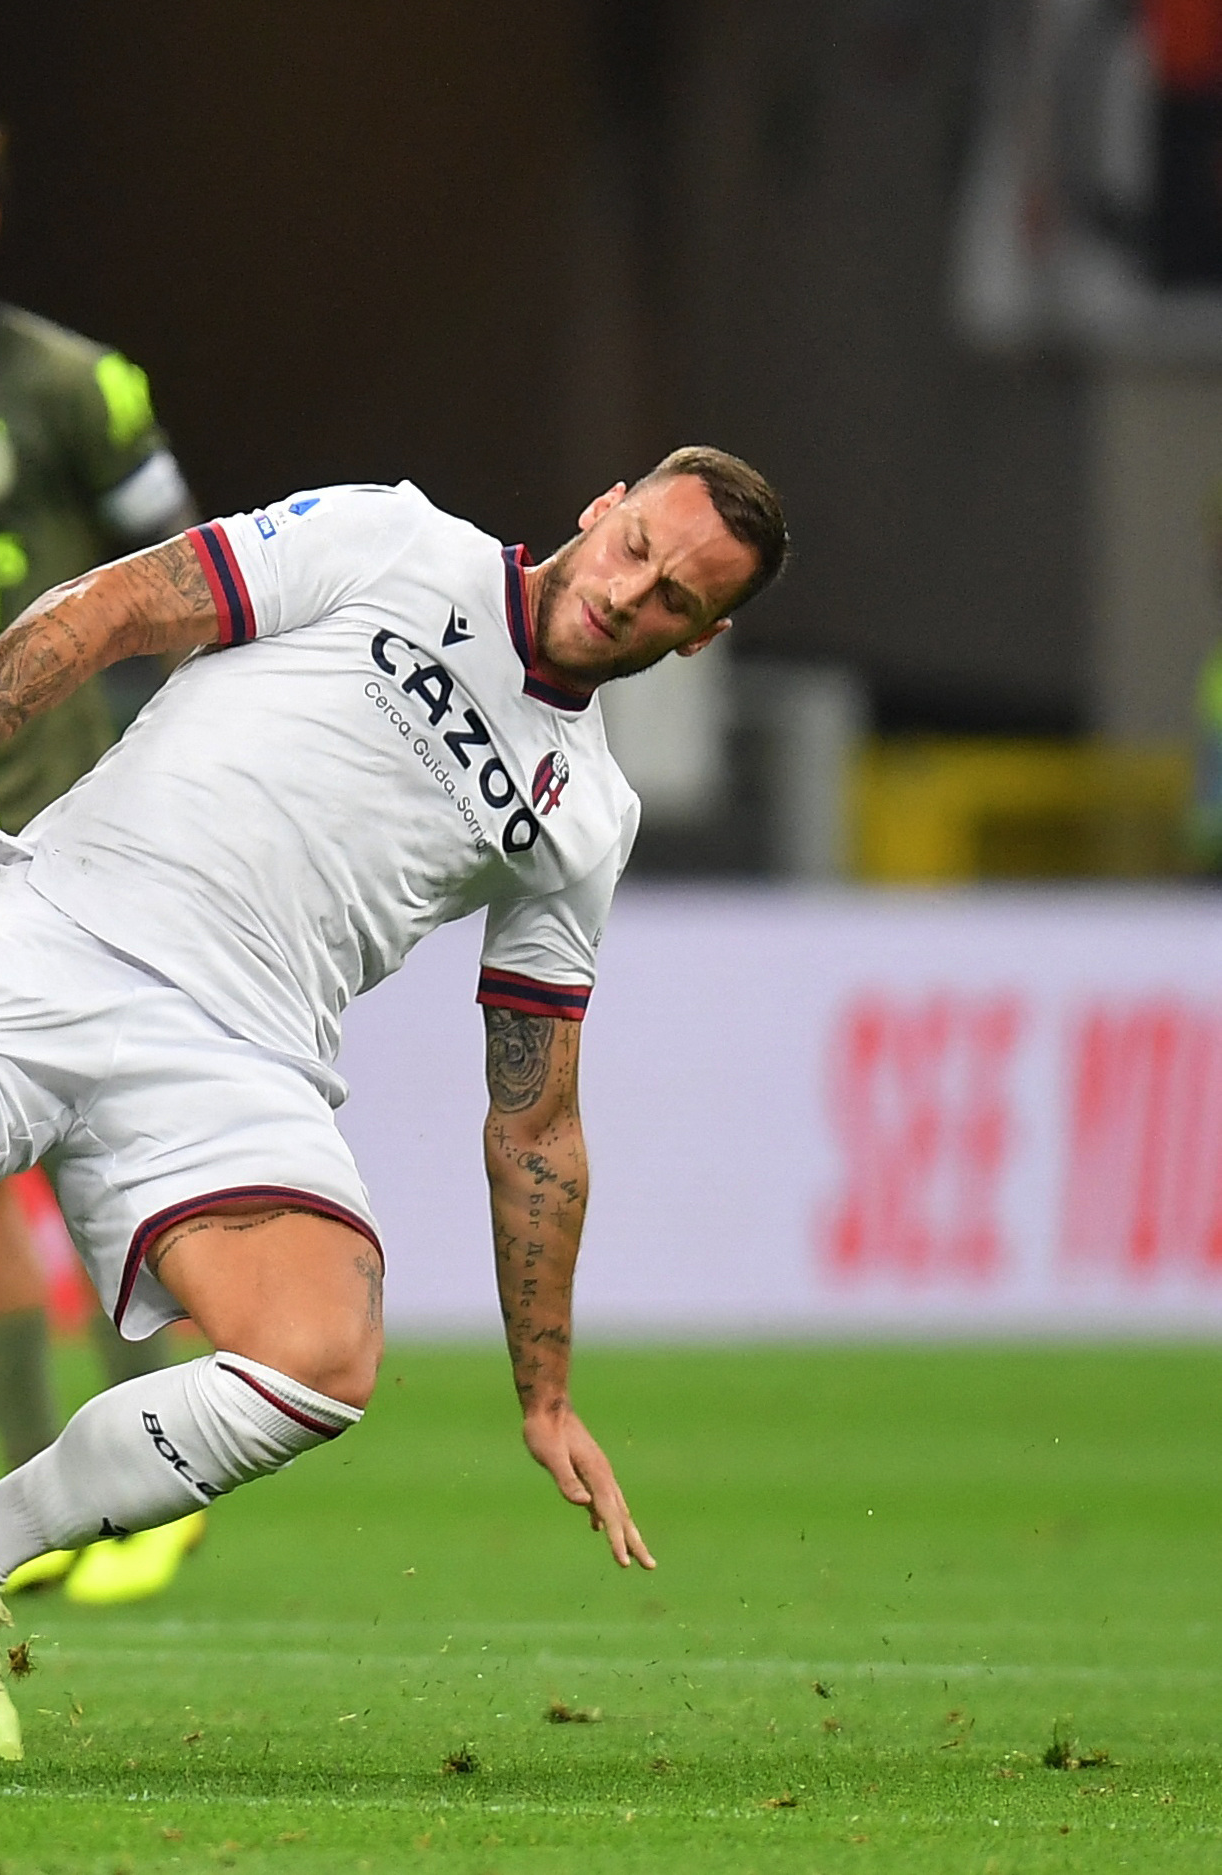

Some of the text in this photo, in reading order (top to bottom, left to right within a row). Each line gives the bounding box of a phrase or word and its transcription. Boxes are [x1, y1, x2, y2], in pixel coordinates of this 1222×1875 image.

[364, 681, 412, 741] Cerca.
[413, 738, 456, 799] Guida.
[371, 628, 540, 854] CAZOO
